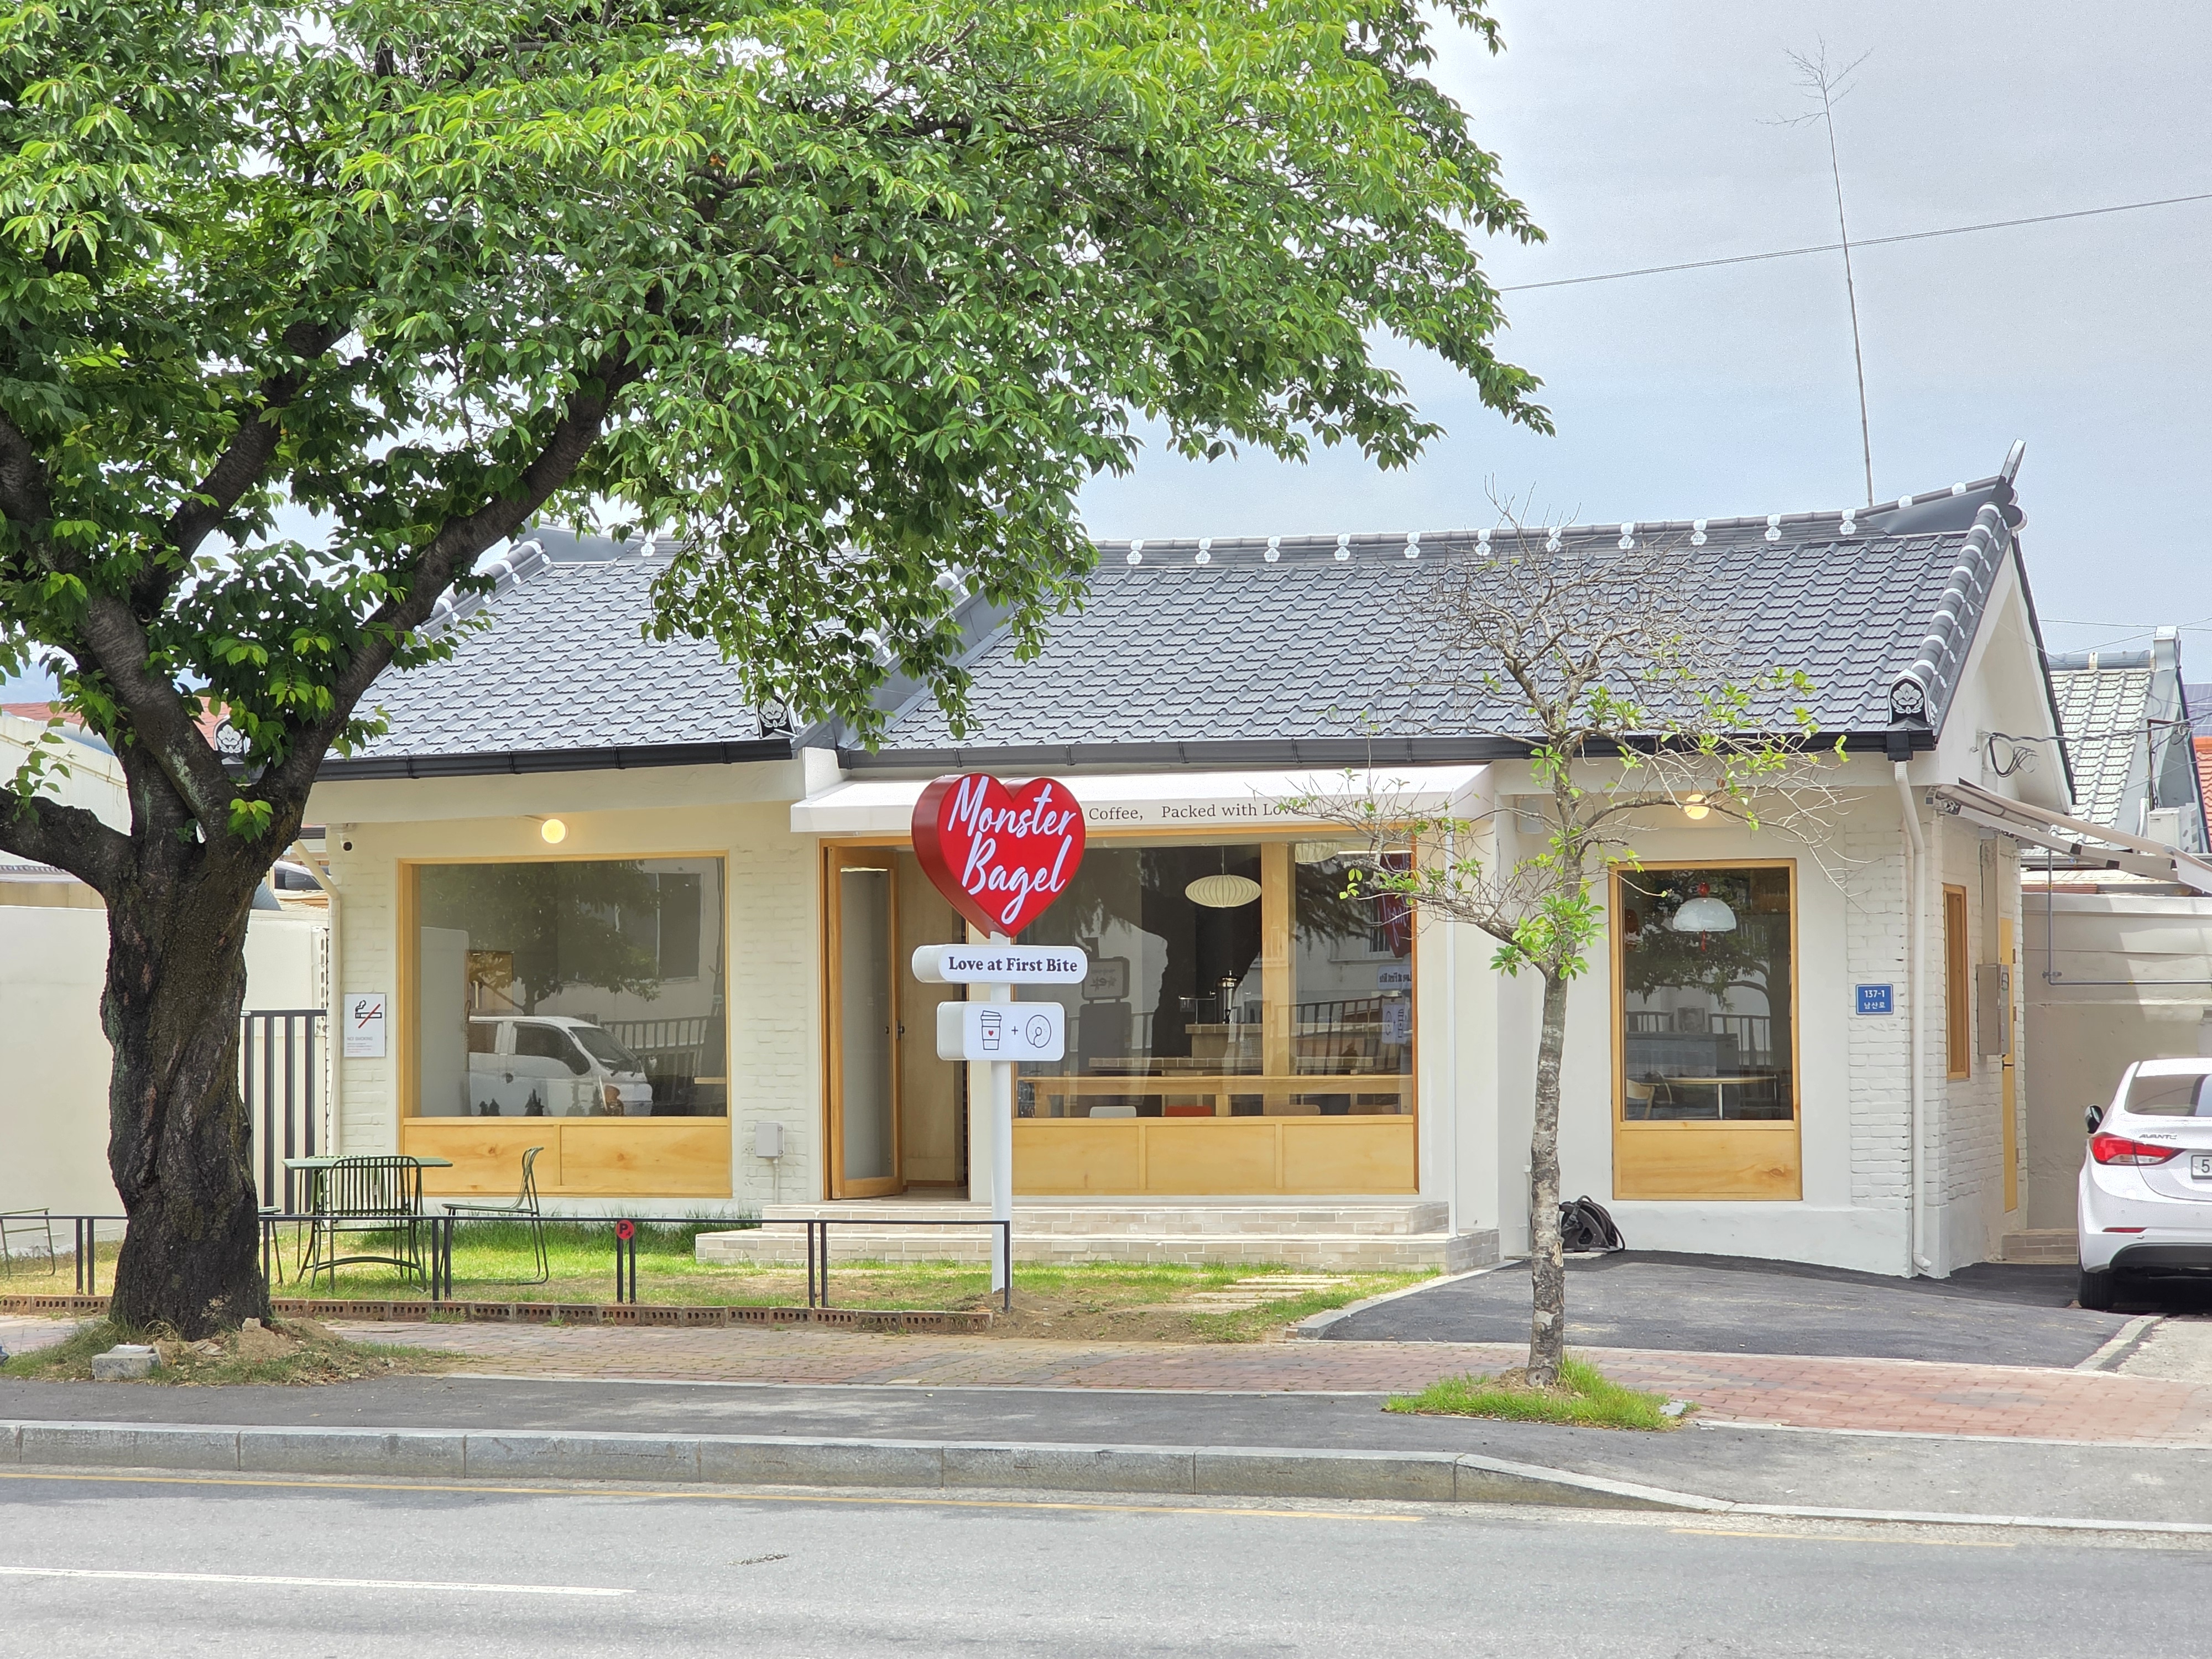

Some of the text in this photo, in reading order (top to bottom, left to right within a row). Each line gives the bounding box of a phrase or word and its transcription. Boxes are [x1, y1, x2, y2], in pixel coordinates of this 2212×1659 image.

[948, 776, 1076, 838] Monster
[1089, 807, 1143, 821] Coffee,
[1161, 804, 1216, 818] Packed
[1222, 804, 1257, 816] with
[962, 831, 1072, 924] Bagel
[948, 957, 983, 971] Love
[987, 959, 1003, 971] at
[1006, 958, 1043, 972] First
[1046, 958, 1078, 972] Bite
[1864, 990, 1885, 998] 137-1
[1864, 1001, 1886, 1010] 남산로
